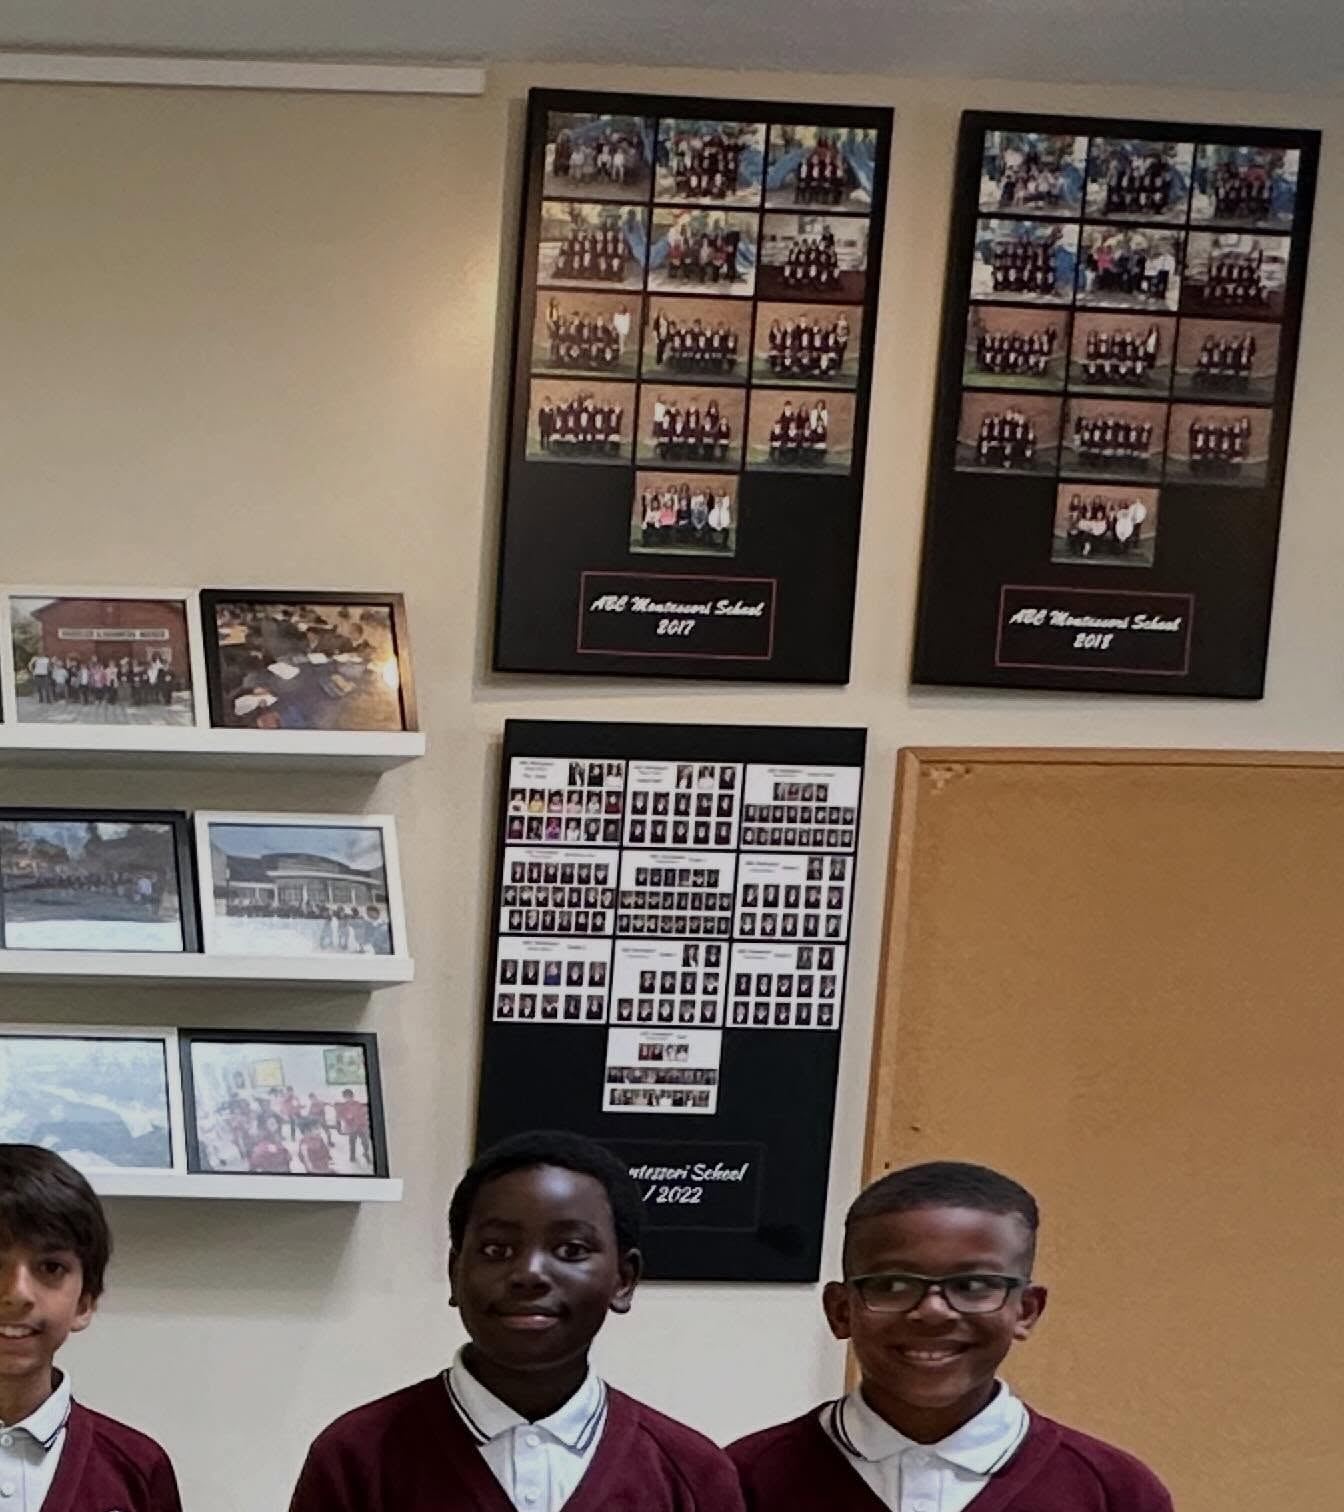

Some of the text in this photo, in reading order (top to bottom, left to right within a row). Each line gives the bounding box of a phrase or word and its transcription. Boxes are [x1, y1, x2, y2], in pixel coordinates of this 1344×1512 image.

[656, 618, 696, 636] 2017
[690, 1161, 750, 1182] School
[656, 1186, 704, 1204] 2022
